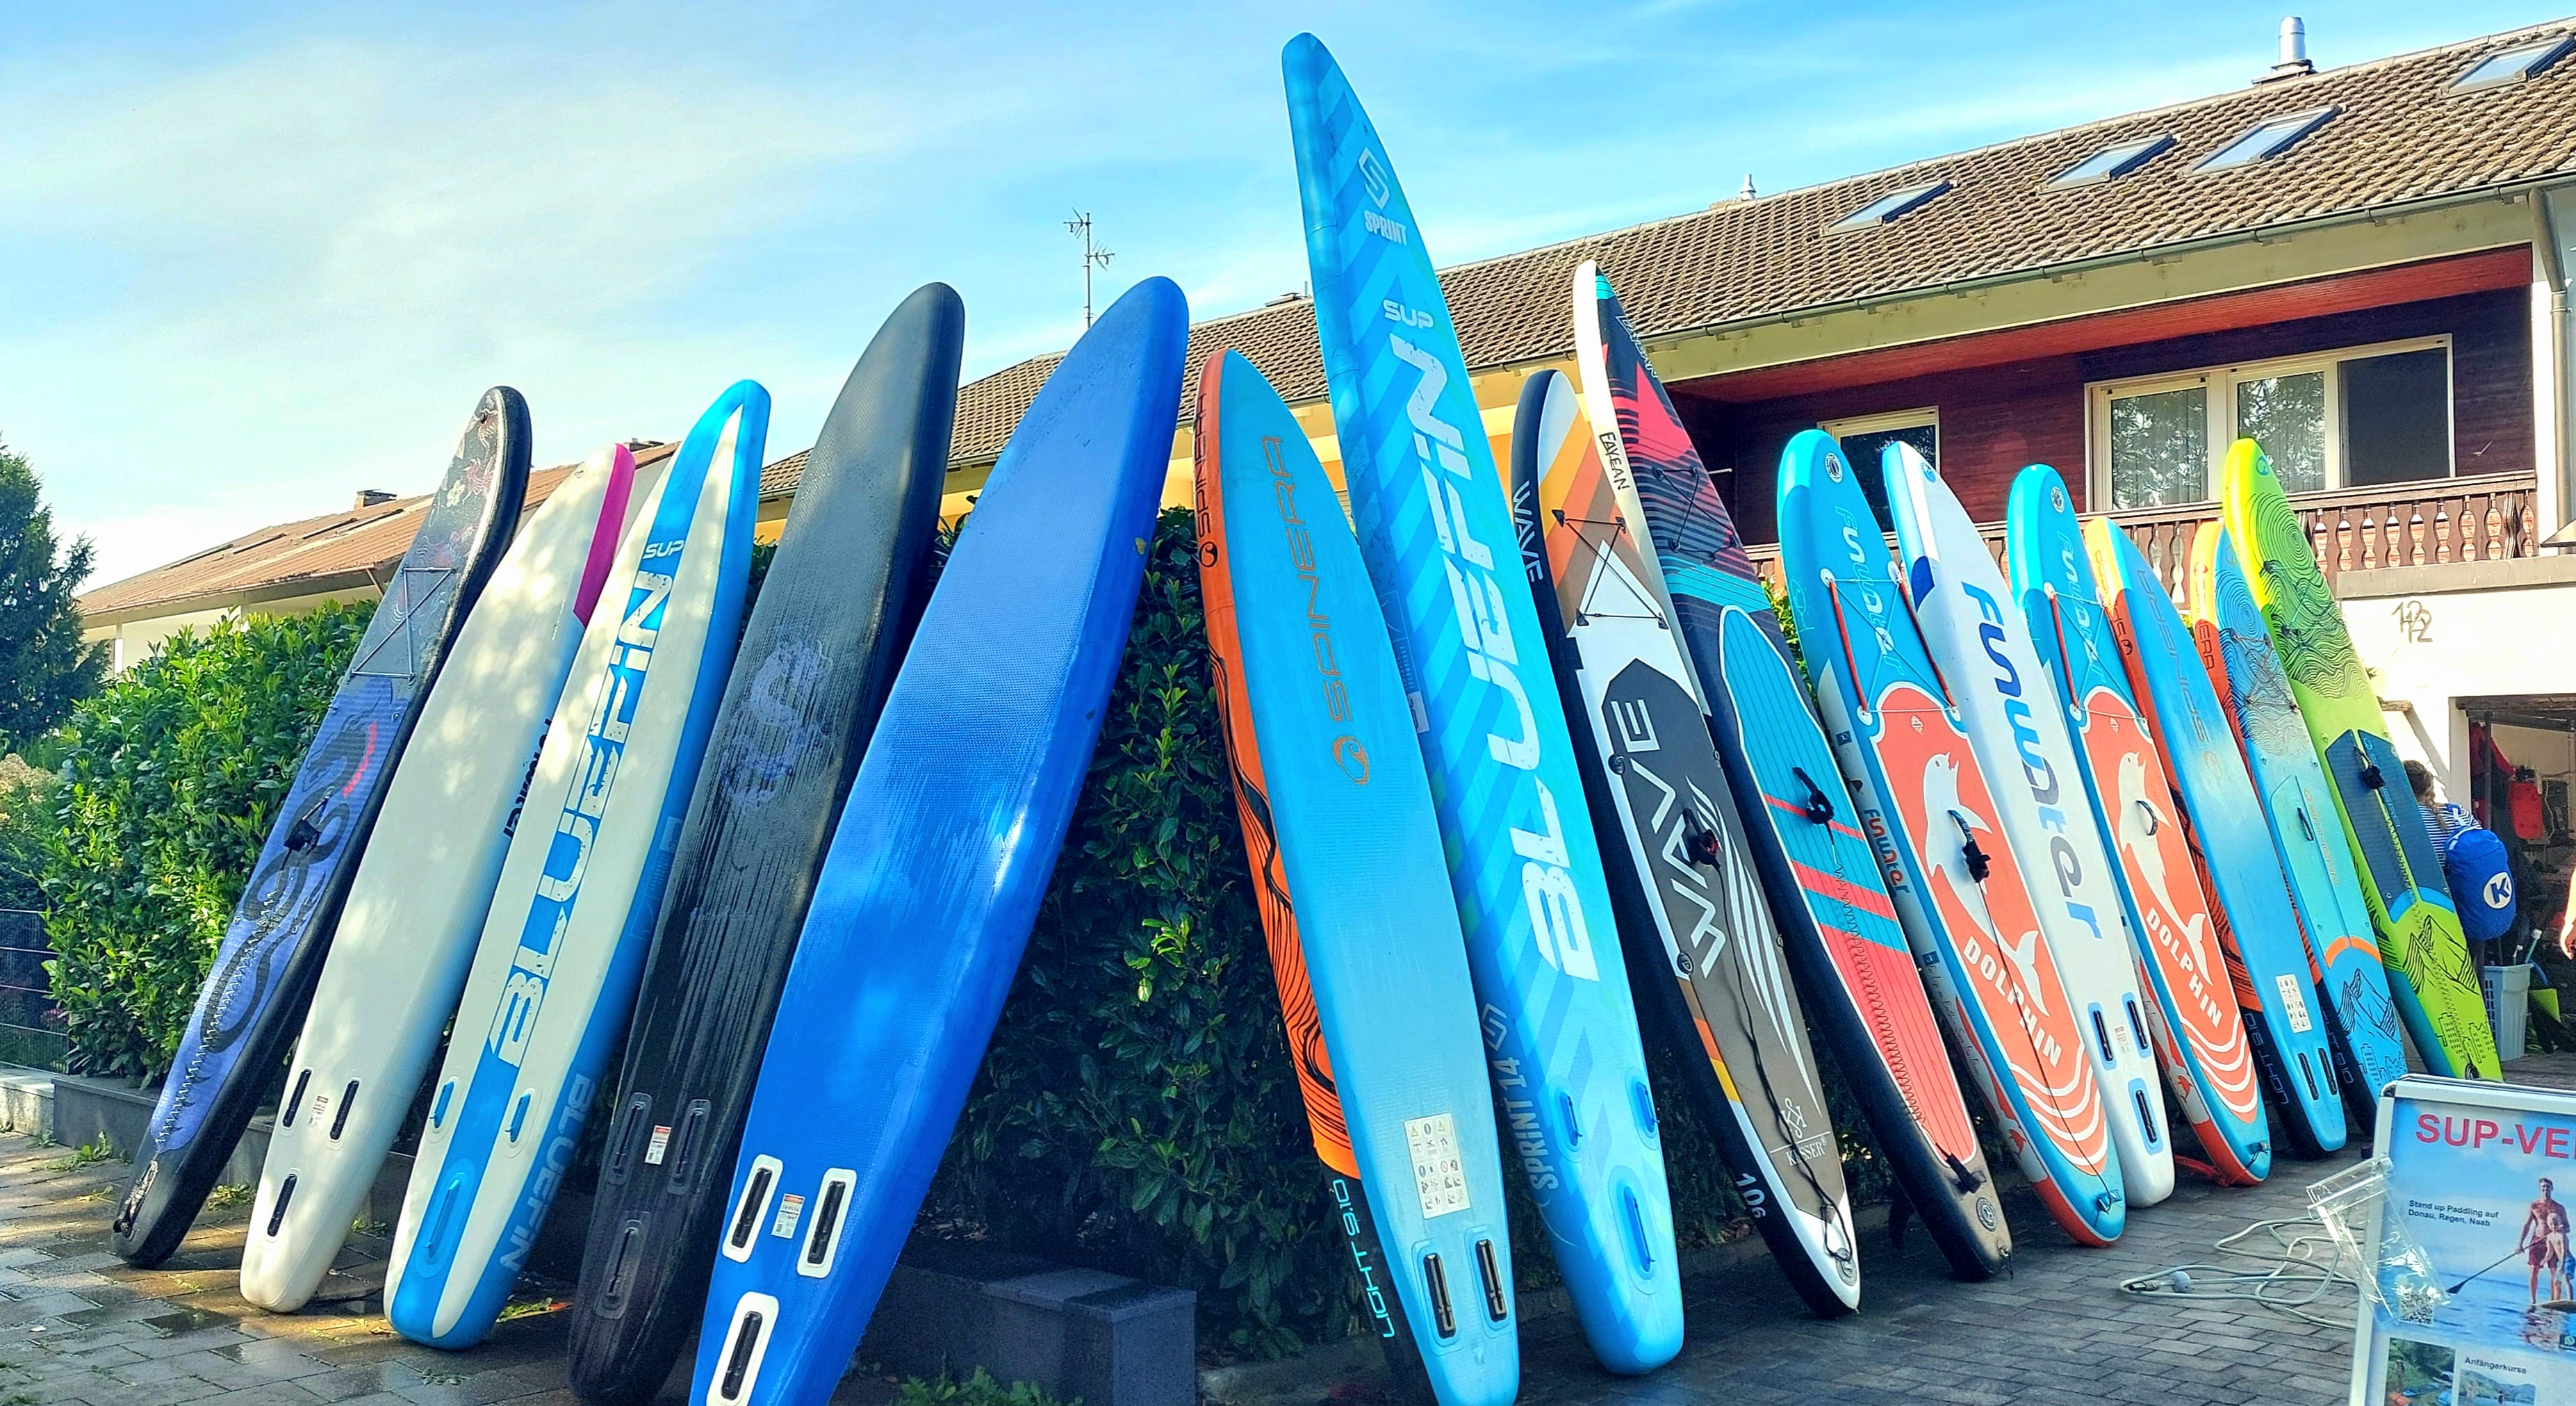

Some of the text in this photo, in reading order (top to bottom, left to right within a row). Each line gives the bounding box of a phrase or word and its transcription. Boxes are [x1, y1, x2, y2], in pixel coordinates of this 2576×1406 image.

[1364, 210, 1407, 245] SPRINT
[1383, 299, 1434, 329] SUP
[1195, 393, 1211, 539] SPINERA
[643, 539, 685, 559] SUP
[1262, 436, 1352, 723] SPINERA
[1513, 480, 1545, 583] WAVE
[1390, 332, 1600, 982] BLUEFIN
[2137, 569, 2209, 743] SPINERA
[489, 571, 673, 1068] BLUEFIN
[1611, 698, 1727, 979] WAVE
[2491, 877, 2510, 905] K
[1962, 935, 2062, 1068] DOLPHIN
[2145, 906, 2223, 1029] DOLPHIN
[1498, 1056, 1559, 1190] SPRINT 14
[2258, 1049, 2289, 1105] LIGHT
[499, 1073, 597, 1273] BLUEFIN
[2415, 1113, 2576, 1160] SUP-VE
[2408, 1209, 2491, 1227] Donau, Regen, Naab
[2409, 1200, 2432, 1210] Stand
[2434, 1204, 2445, 1212] up
[2447, 1205, 2483, 1219] Paddling
[1349, 1241, 1395, 1339] LIGHT
[2465, 1357, 2527, 1375] Anfängerkurse
